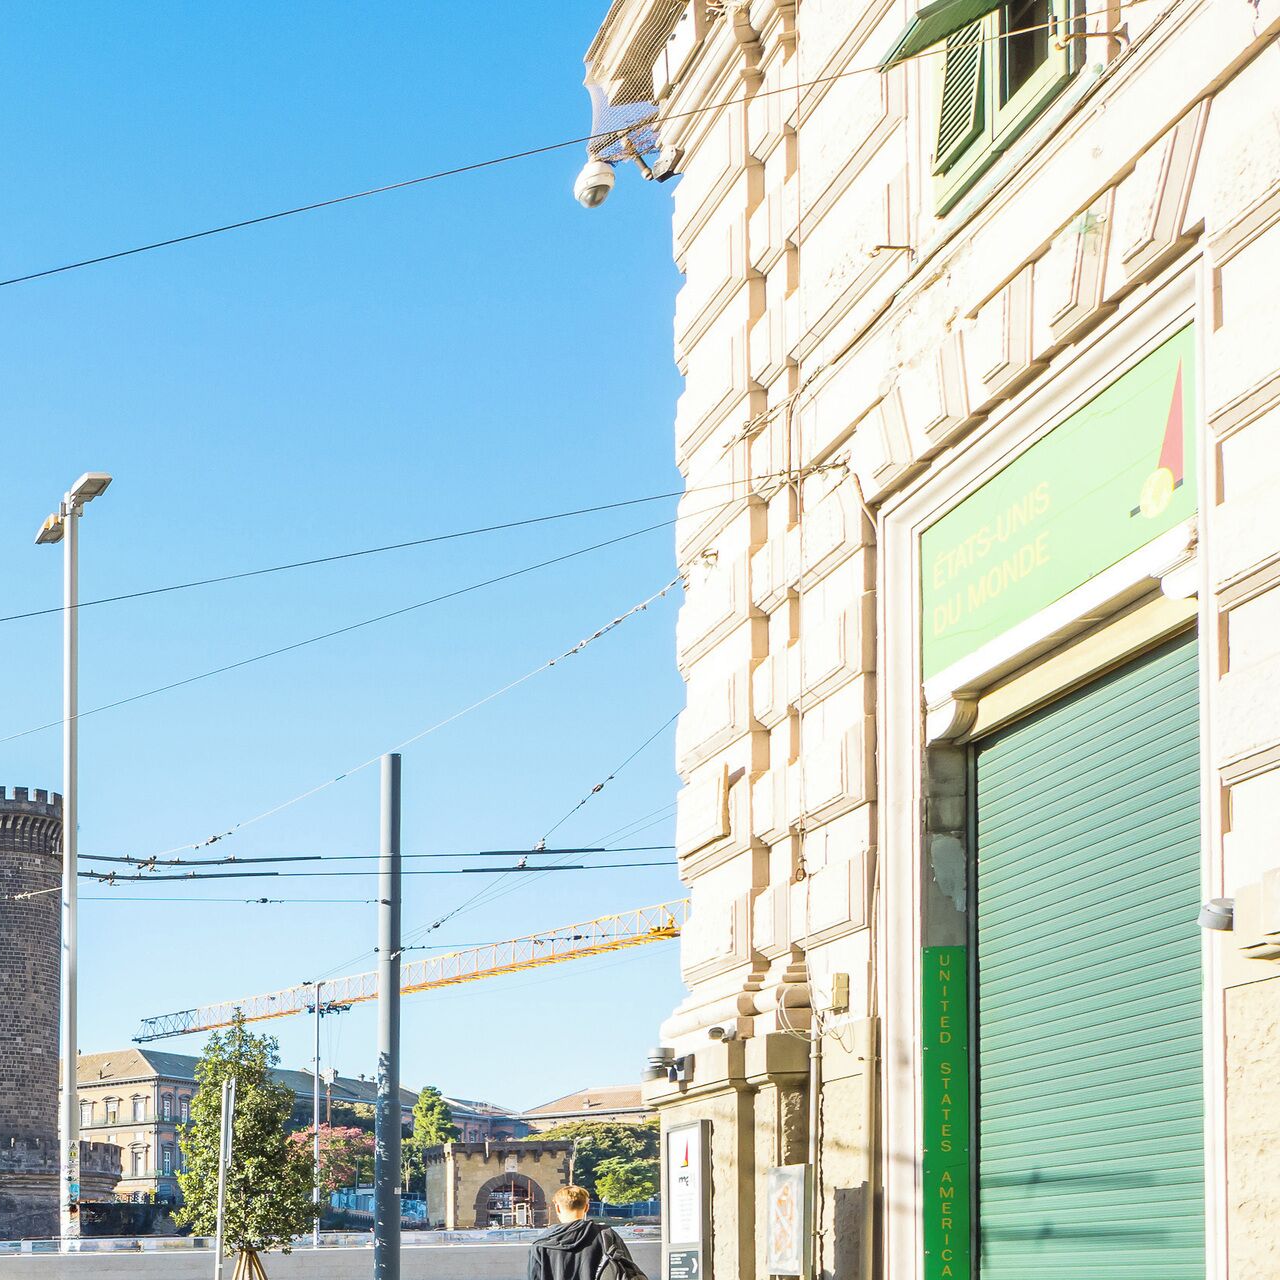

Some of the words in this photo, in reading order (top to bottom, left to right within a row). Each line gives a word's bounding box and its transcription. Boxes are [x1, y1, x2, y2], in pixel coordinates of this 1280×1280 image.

[933, 592, 962, 636] DU
[967, 530, 1051, 613] MONDE
[939, 955, 951, 1044] UNITED
[940, 1062, 952, 1152] STATES
